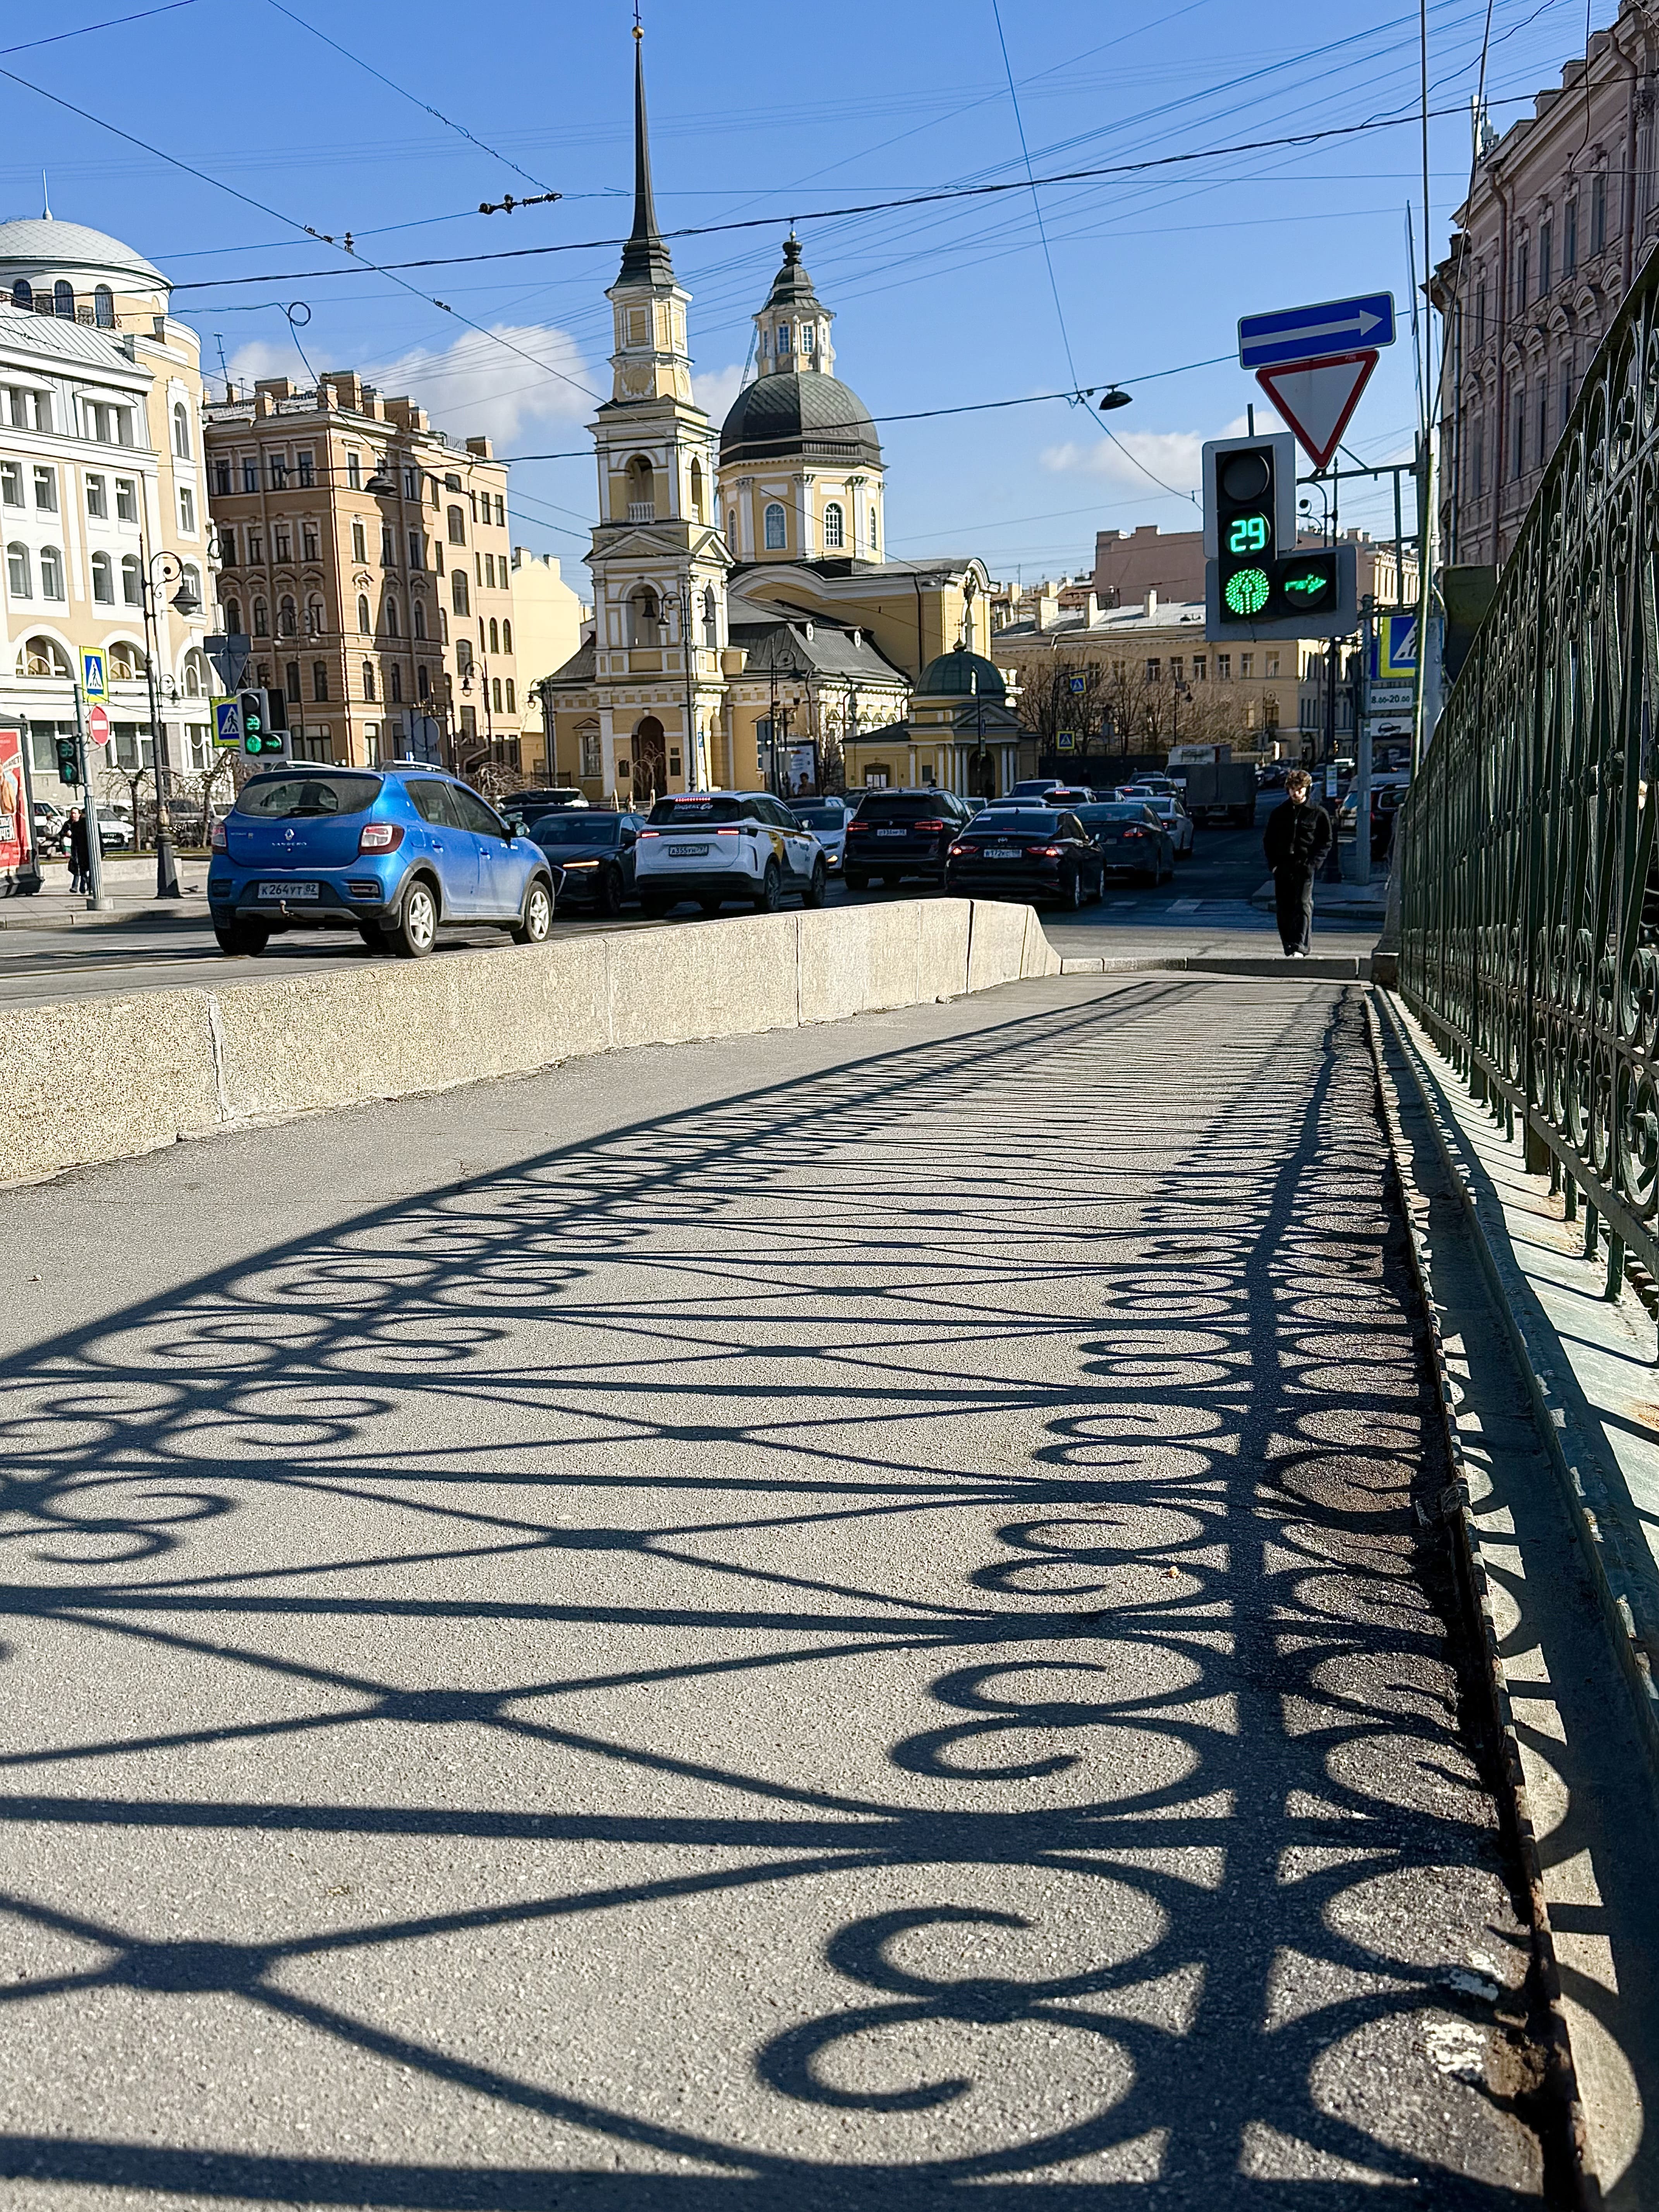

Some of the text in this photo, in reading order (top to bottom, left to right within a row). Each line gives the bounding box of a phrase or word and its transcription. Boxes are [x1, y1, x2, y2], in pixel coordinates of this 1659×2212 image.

[1231, 517, 1265, 552] 29
[246, 718, 259, 731] 29
[262, 884, 316, 895] К264УТ 82
